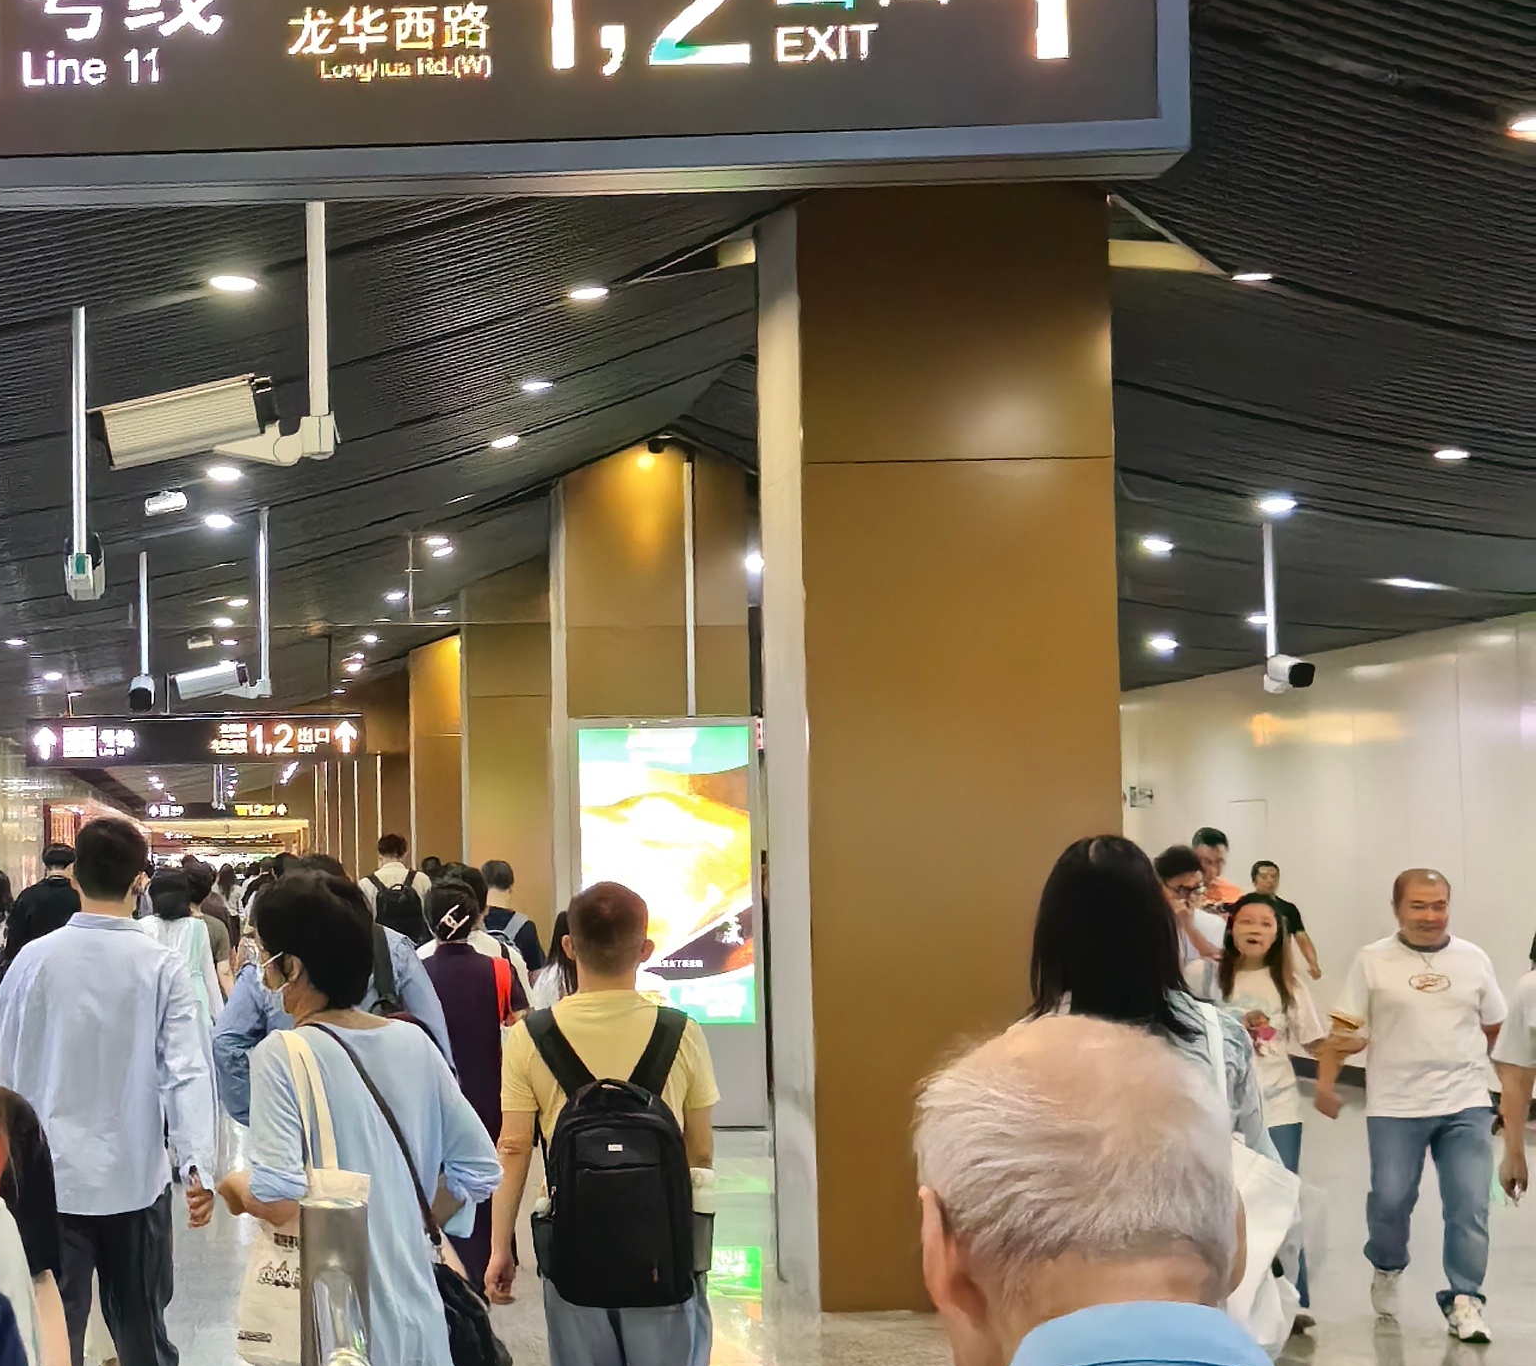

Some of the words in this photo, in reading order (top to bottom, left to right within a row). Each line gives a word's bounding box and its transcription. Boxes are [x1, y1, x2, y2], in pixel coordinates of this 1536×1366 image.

[287, 2, 490, 55] 龙华西路
[775, 23, 878, 63] EXIT
[22, 49, 108, 87] Line
[123, 46, 161, 84] 11
[249, 723, 294, 756] 1,2
[297, 726, 331, 744] 出口
